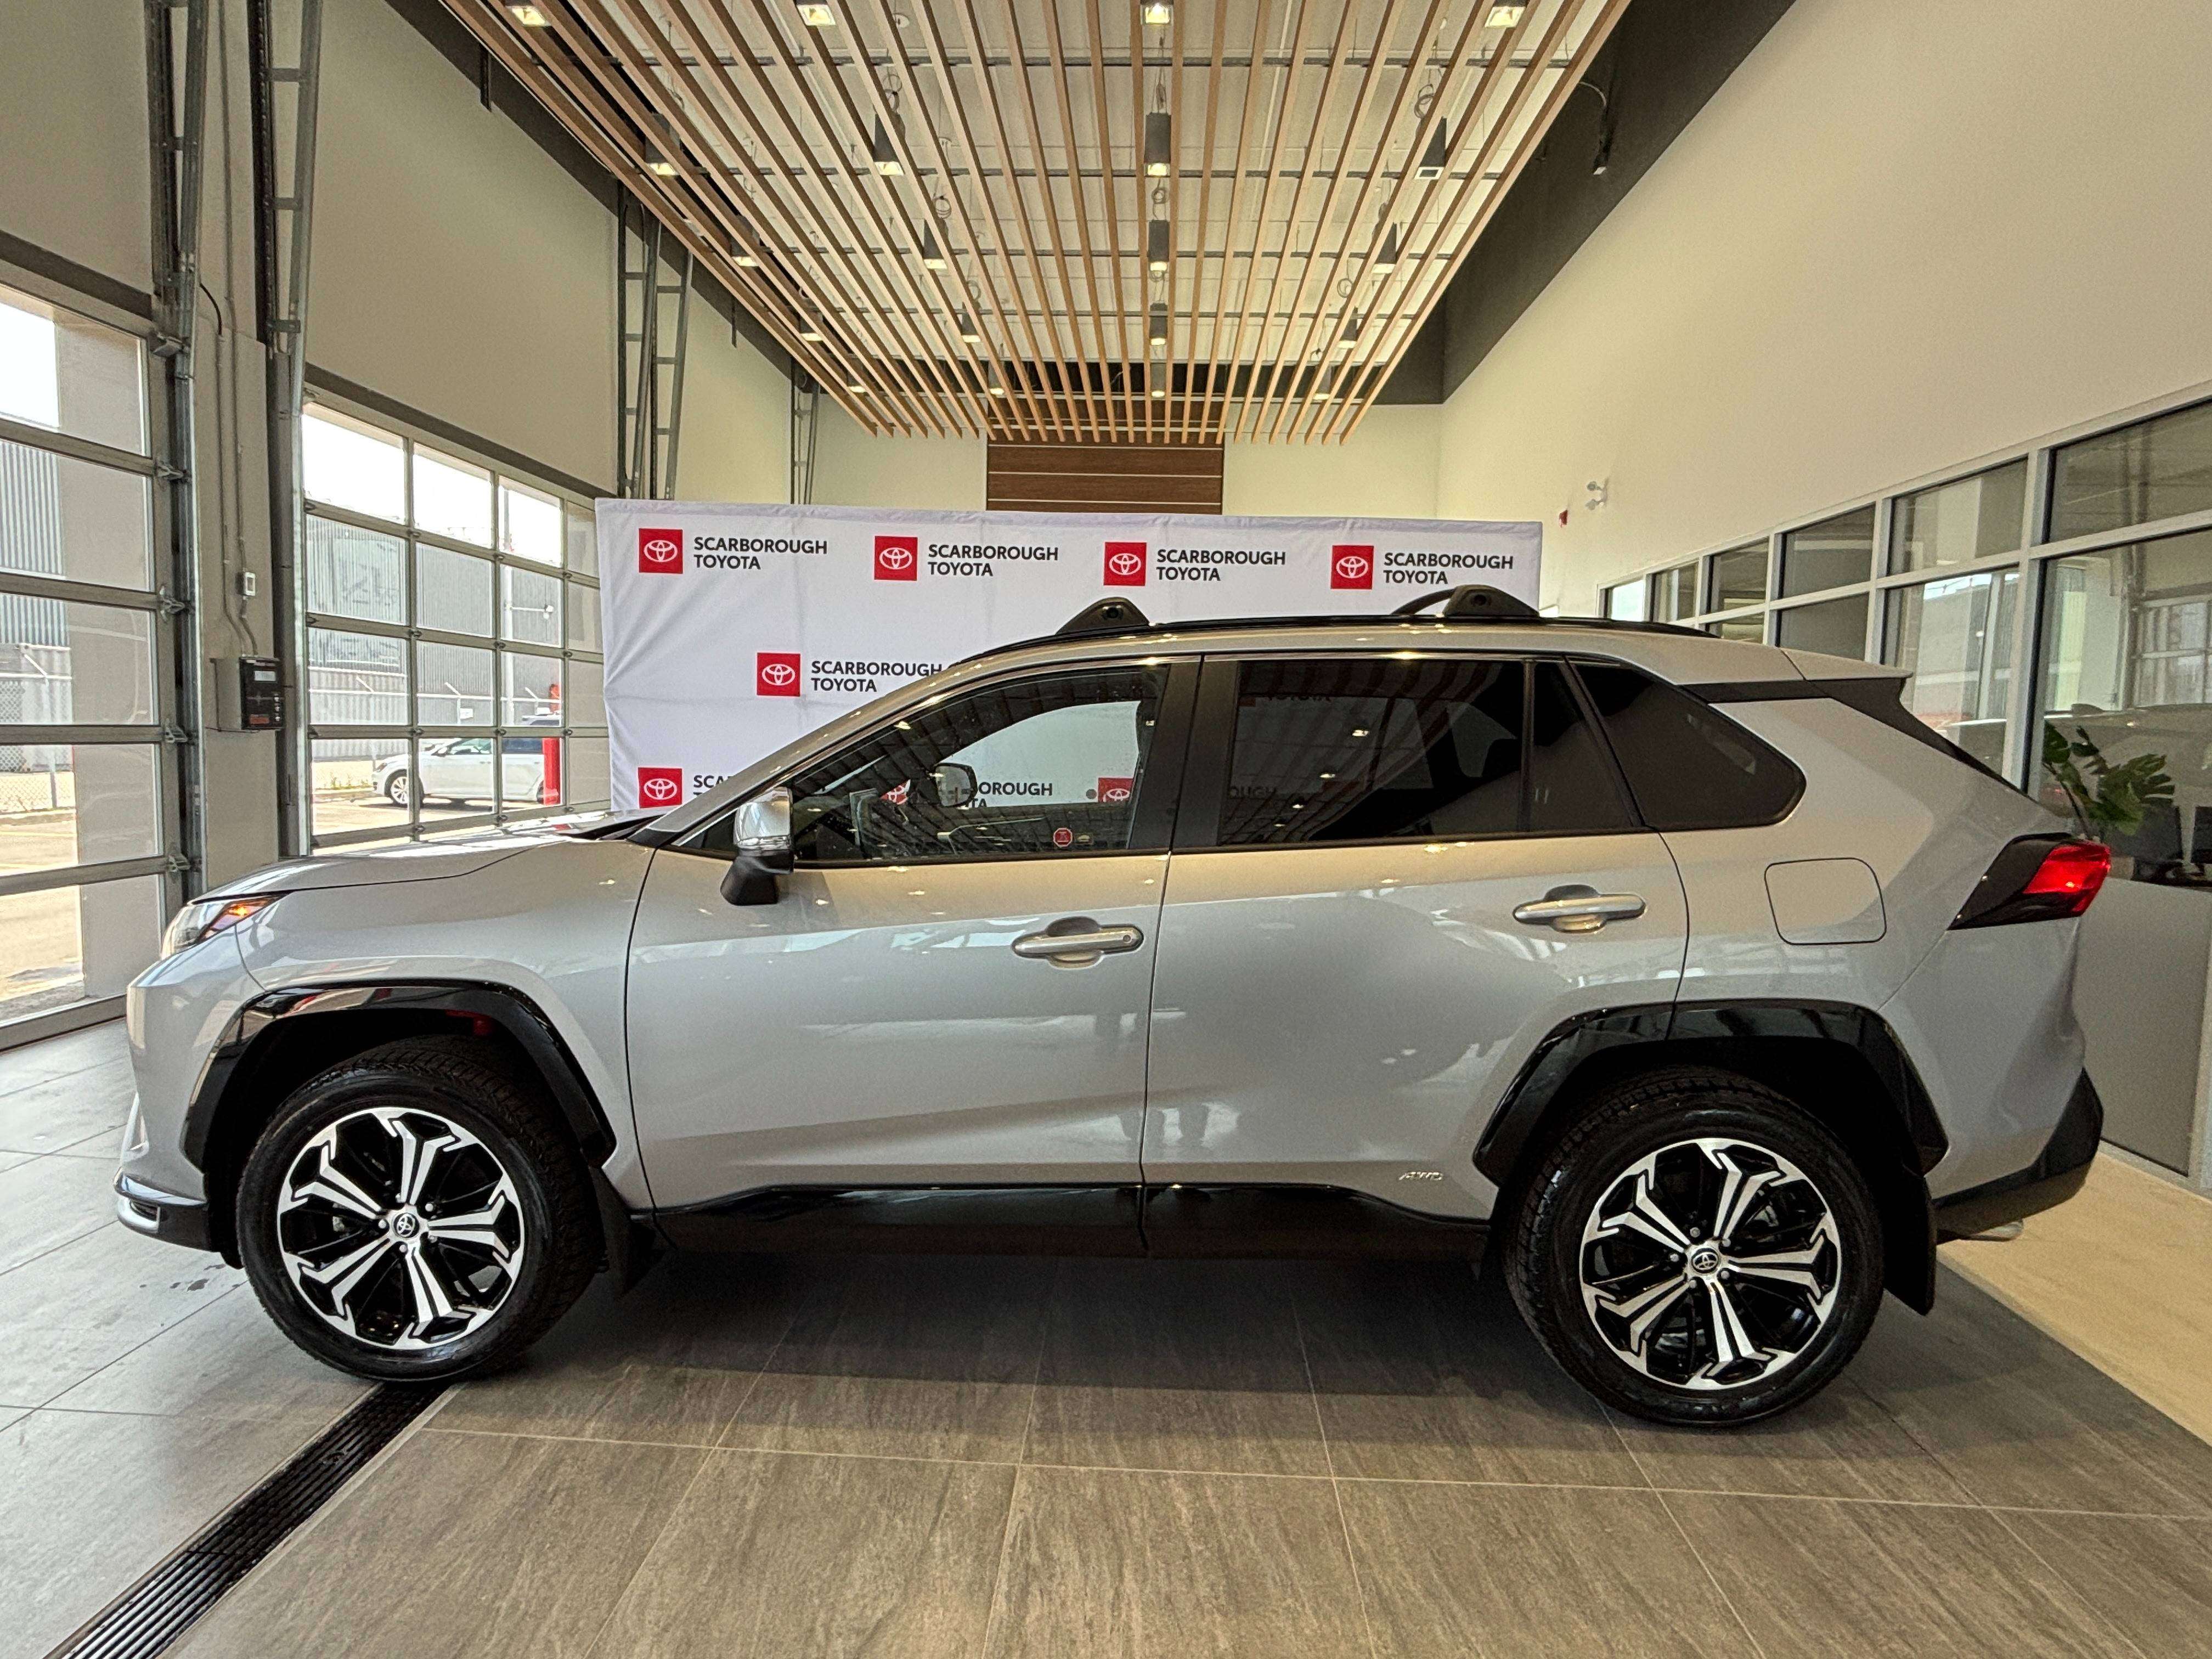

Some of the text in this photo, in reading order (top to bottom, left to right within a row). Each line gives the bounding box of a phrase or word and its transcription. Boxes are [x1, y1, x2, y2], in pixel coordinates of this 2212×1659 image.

[694, 537, 827, 554] SCARBOROUGH
[928, 544, 1059, 561] SCARBOROUGH
[693, 554, 761, 570] TOYOTA
[1156, 549, 1286, 566] SCARBOROUGH
[1384, 552, 1514, 569] SCARBOROUGH
[928, 561, 994, 577] TOYOTA
[1156, 566, 1221, 582] TOYOTA
[1383, 569, 1448, 585] TOYOTA
[811, 661, 943, 676] SCARBOROUGH
[810, 678, 877, 692] TOYOTA
[978, 781, 1053, 796] OROUGH
[1399, 1171, 1444, 1181] AWD
